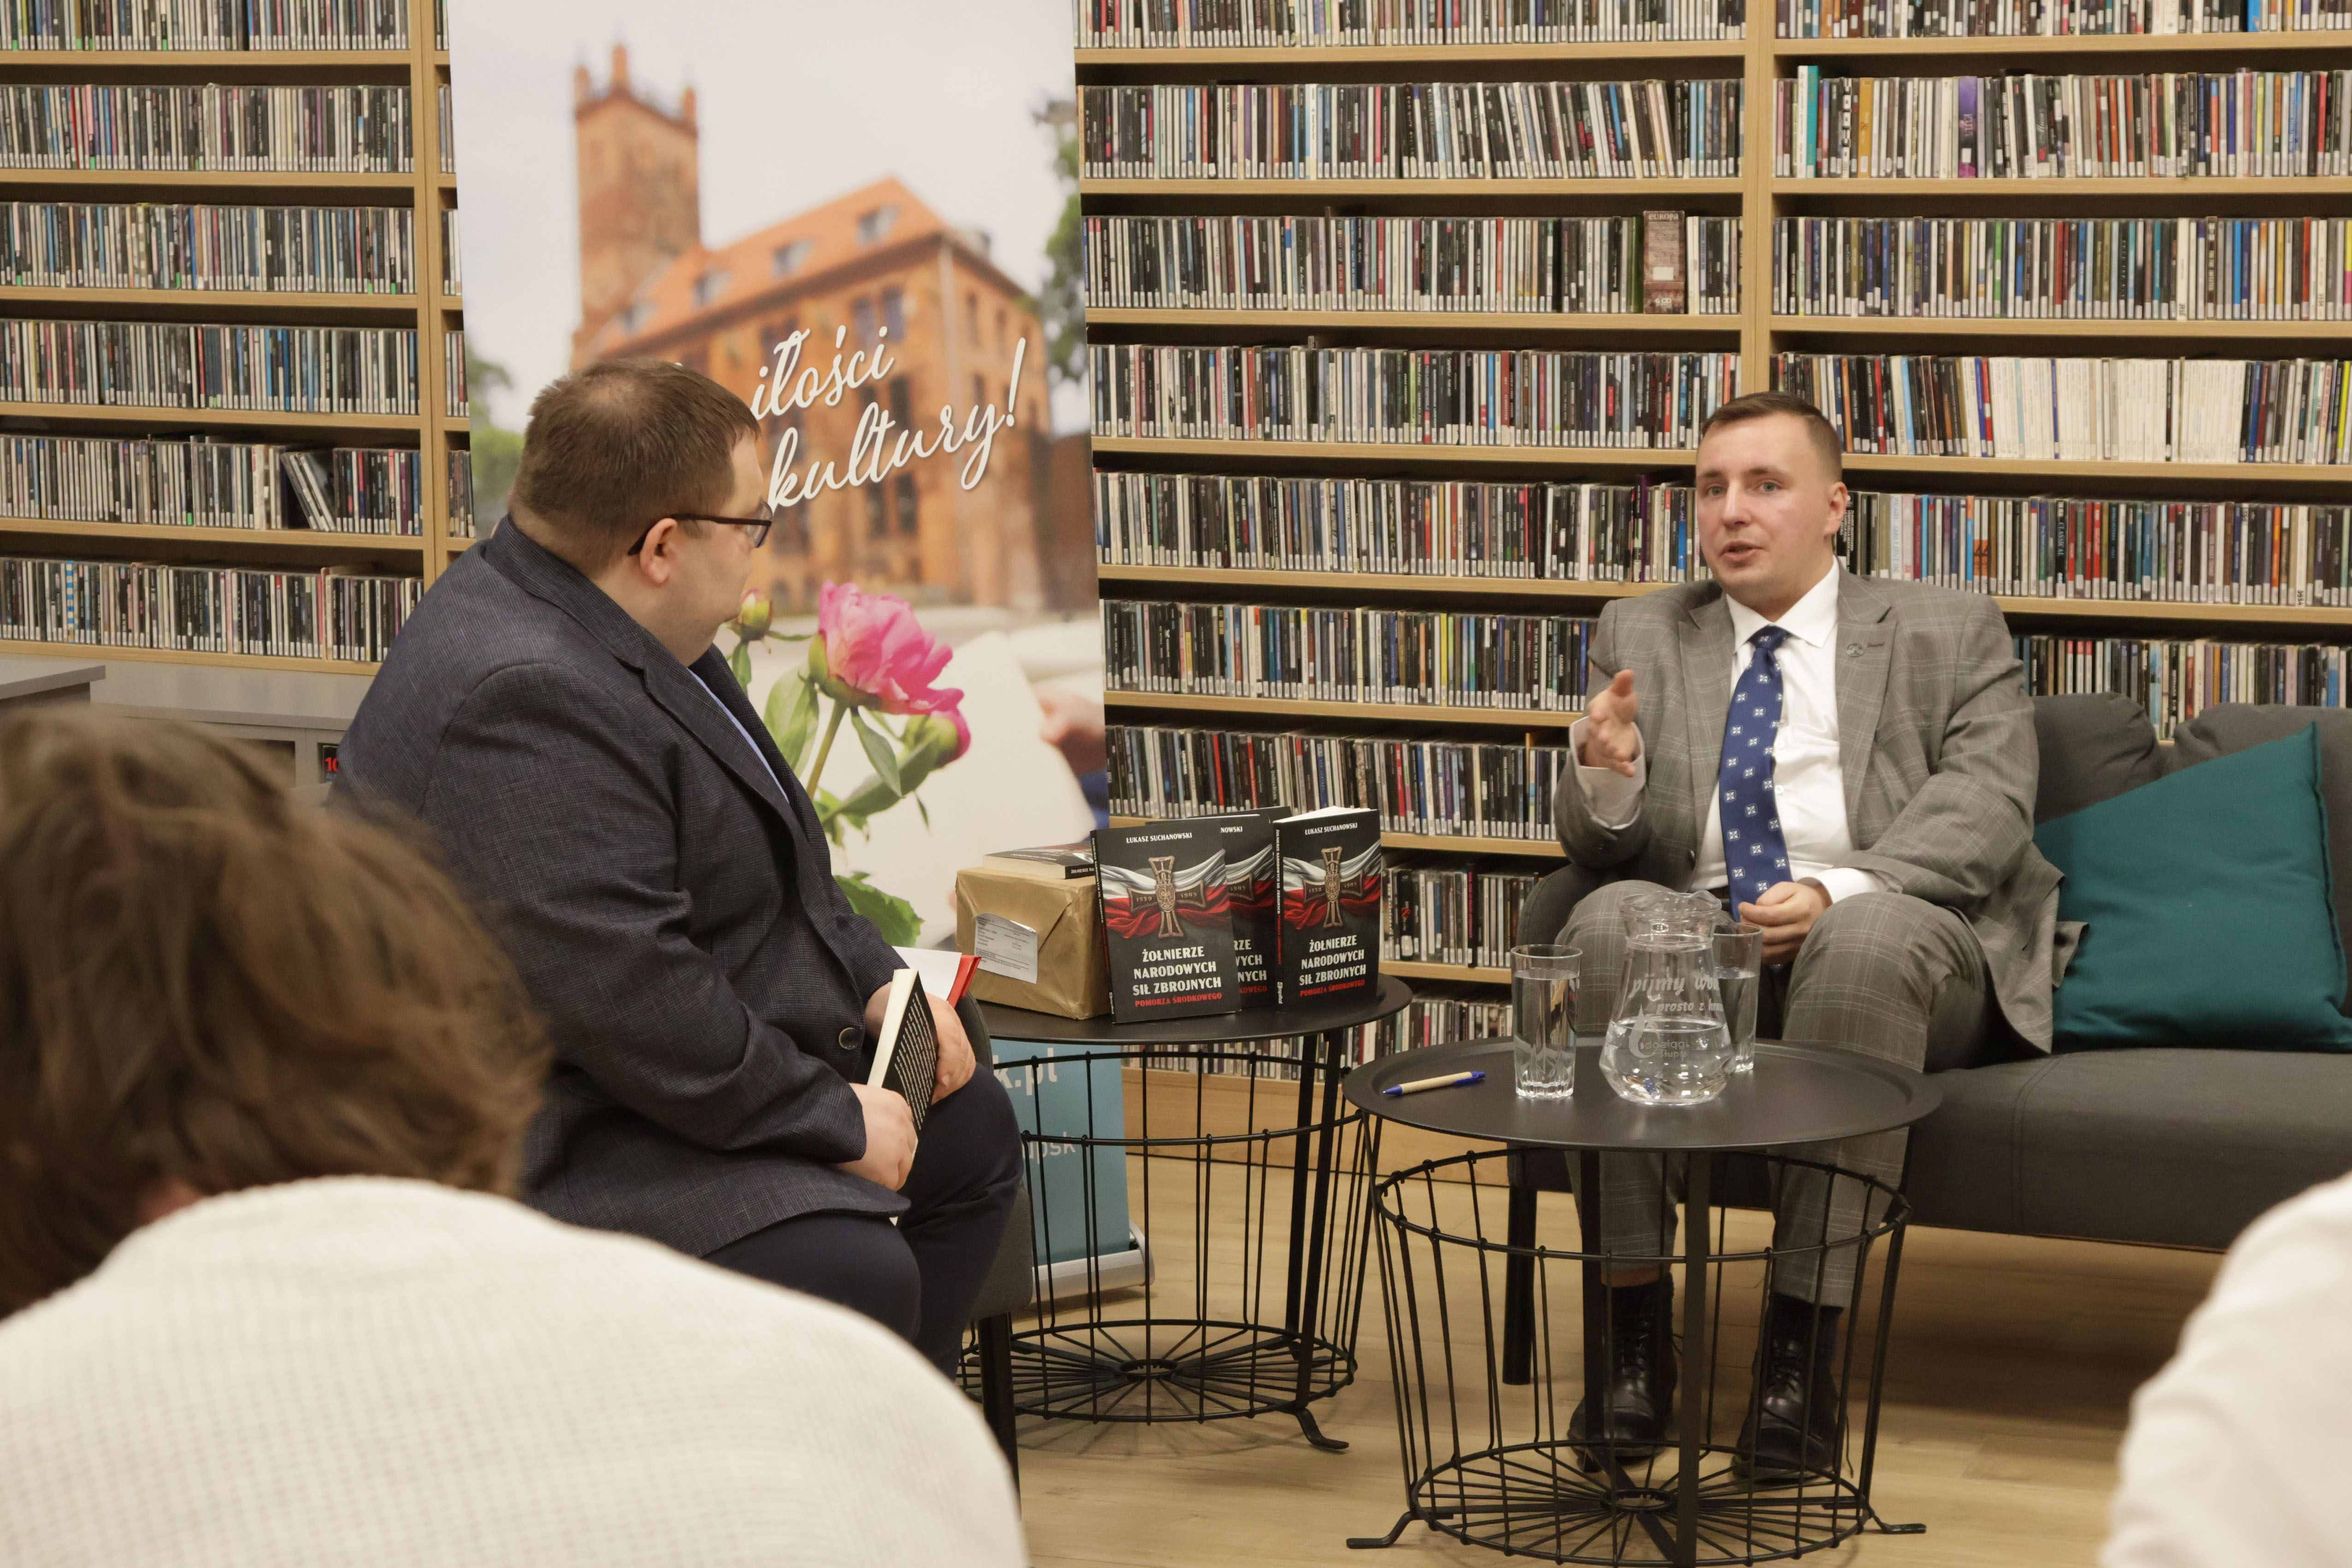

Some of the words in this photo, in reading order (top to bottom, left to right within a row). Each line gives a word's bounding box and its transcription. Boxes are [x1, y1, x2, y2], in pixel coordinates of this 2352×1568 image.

[751, 325, 895, 420] iłości
[768, 337, 1026, 514] kultury!
[1324, 822, 1358, 834] SUCHANOWSKI
[1126, 834, 1149, 843] ŁUKASZ
[1150, 832, 1192, 842] SUCHANOWSKI
[1309, 935, 1357, 953] ŻOŁNIERZE
[1142, 946, 1205, 962] ŻOŁNIERZE
[1301, 949, 1365, 970] NARODOWYCH
[1134, 961, 1217, 979] NARODOWYCH
[1299, 974, 1313, 986] SIŁ
[1315, 964, 1366, 984] ZBROJNYCH
[1132, 983, 1151, 996] SIŁ
[1154, 977, 1222, 994] ZBROJNYCH
[1300, 988, 1327, 996] POMORZA
[1329, 979, 1365, 992] ŚRODKOWEGO
[1135, 998, 1171, 1007] POMORZA
[1172, 992, 1222, 1004] ŚRODKOWEGO
[1657, 1002, 1694, 1014] prosto
[1699, 1002, 1704, 1011] z
